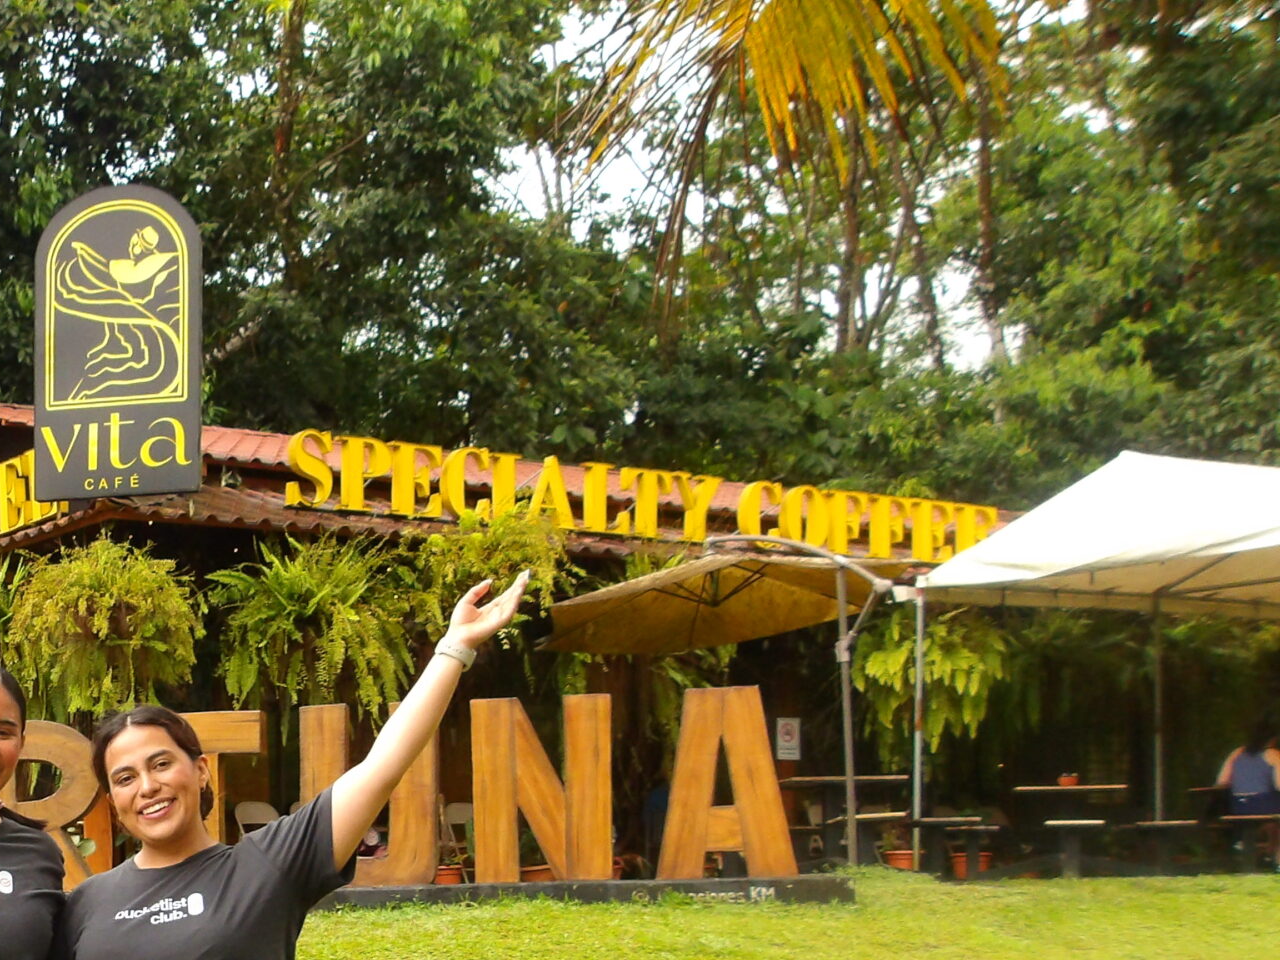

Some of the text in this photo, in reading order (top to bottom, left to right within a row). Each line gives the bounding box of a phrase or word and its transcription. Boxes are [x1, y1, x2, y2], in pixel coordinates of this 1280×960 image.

[40, 412, 192, 474] vita
[84, 473, 140, 491] CAFÉ
[285, 427, 997, 563] SPECIALTY COFFEE
[149, 909, 188, 926] club.
